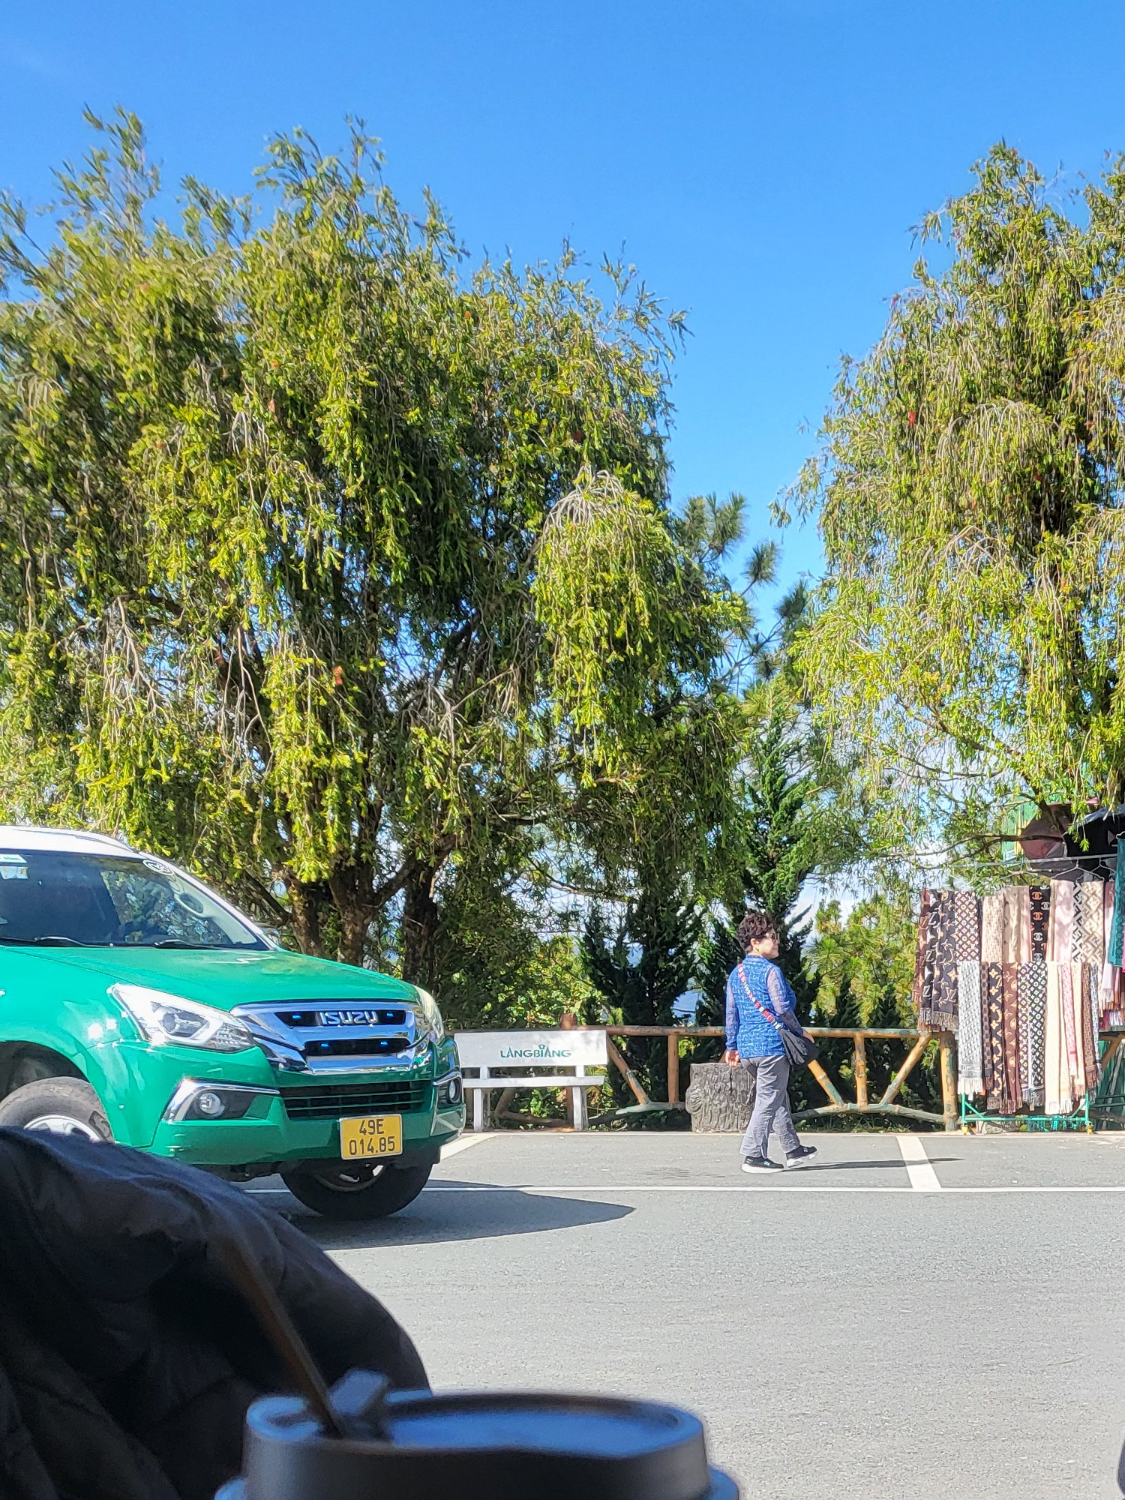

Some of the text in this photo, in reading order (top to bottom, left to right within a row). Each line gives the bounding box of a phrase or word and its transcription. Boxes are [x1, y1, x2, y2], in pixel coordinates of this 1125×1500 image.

[319, 1011, 379, 1025] ISUZU
[500, 1044, 572, 1058] LANGBIANG
[359, 1119, 385, 1135] 49E
[349, 1136, 396, 1156] 014.85
